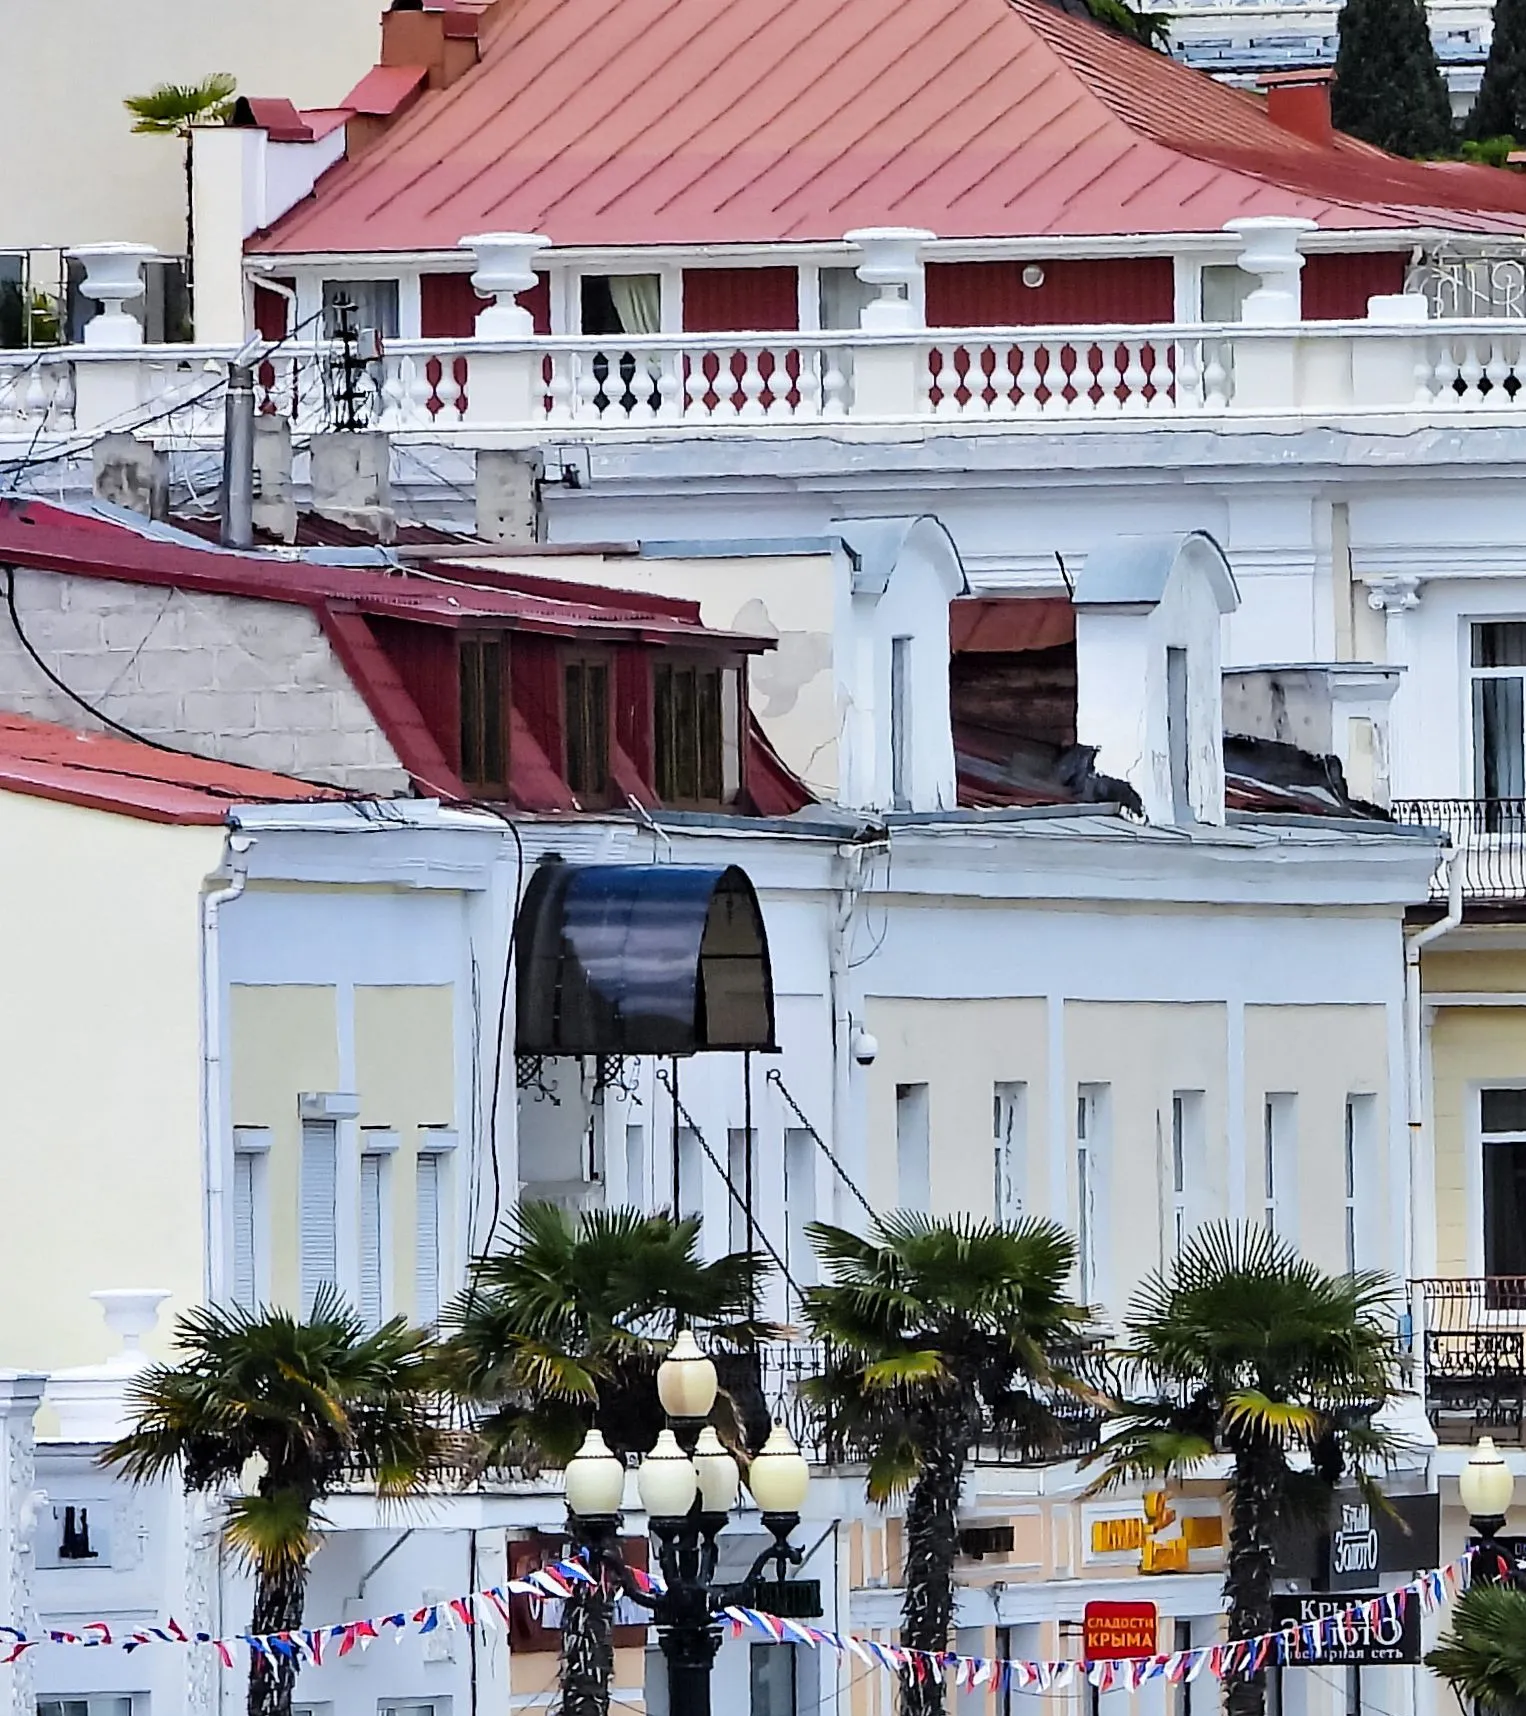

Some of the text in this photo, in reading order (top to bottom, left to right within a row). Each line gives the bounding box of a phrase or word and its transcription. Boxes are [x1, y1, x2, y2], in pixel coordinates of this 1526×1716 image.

[1087, 1616, 1154, 1630] СЛАДОСТИ
[1087, 1633, 1154, 1648] КРЫМА
[1371, 1649, 1404, 1660] сеть
